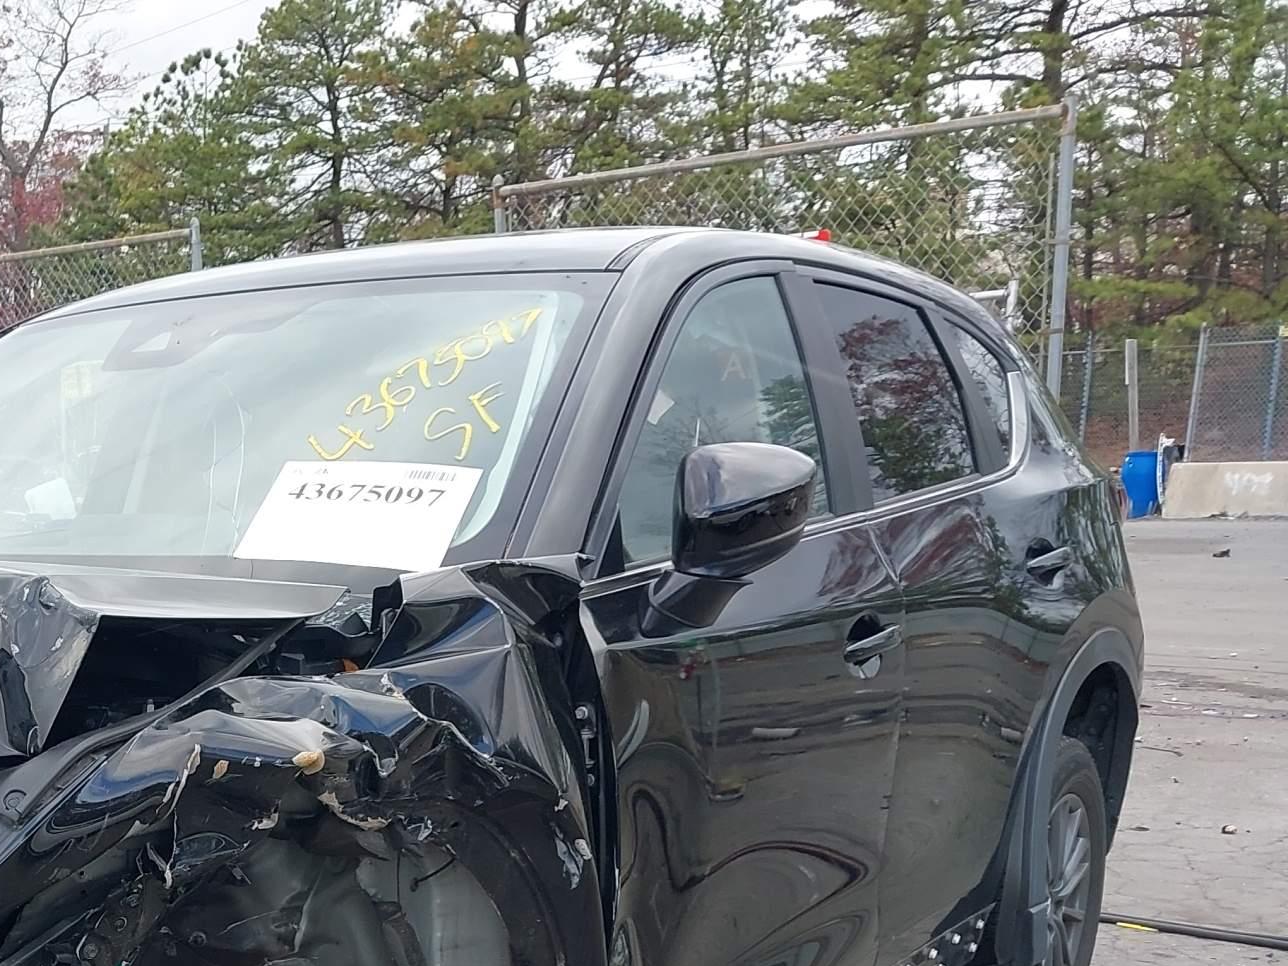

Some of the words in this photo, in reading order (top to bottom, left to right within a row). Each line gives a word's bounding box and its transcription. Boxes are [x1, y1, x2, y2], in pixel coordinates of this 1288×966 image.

[307, 306, 544, 461] 43675097
[423, 381, 505, 461] SF
[288, 481, 448, 507] 43675097
